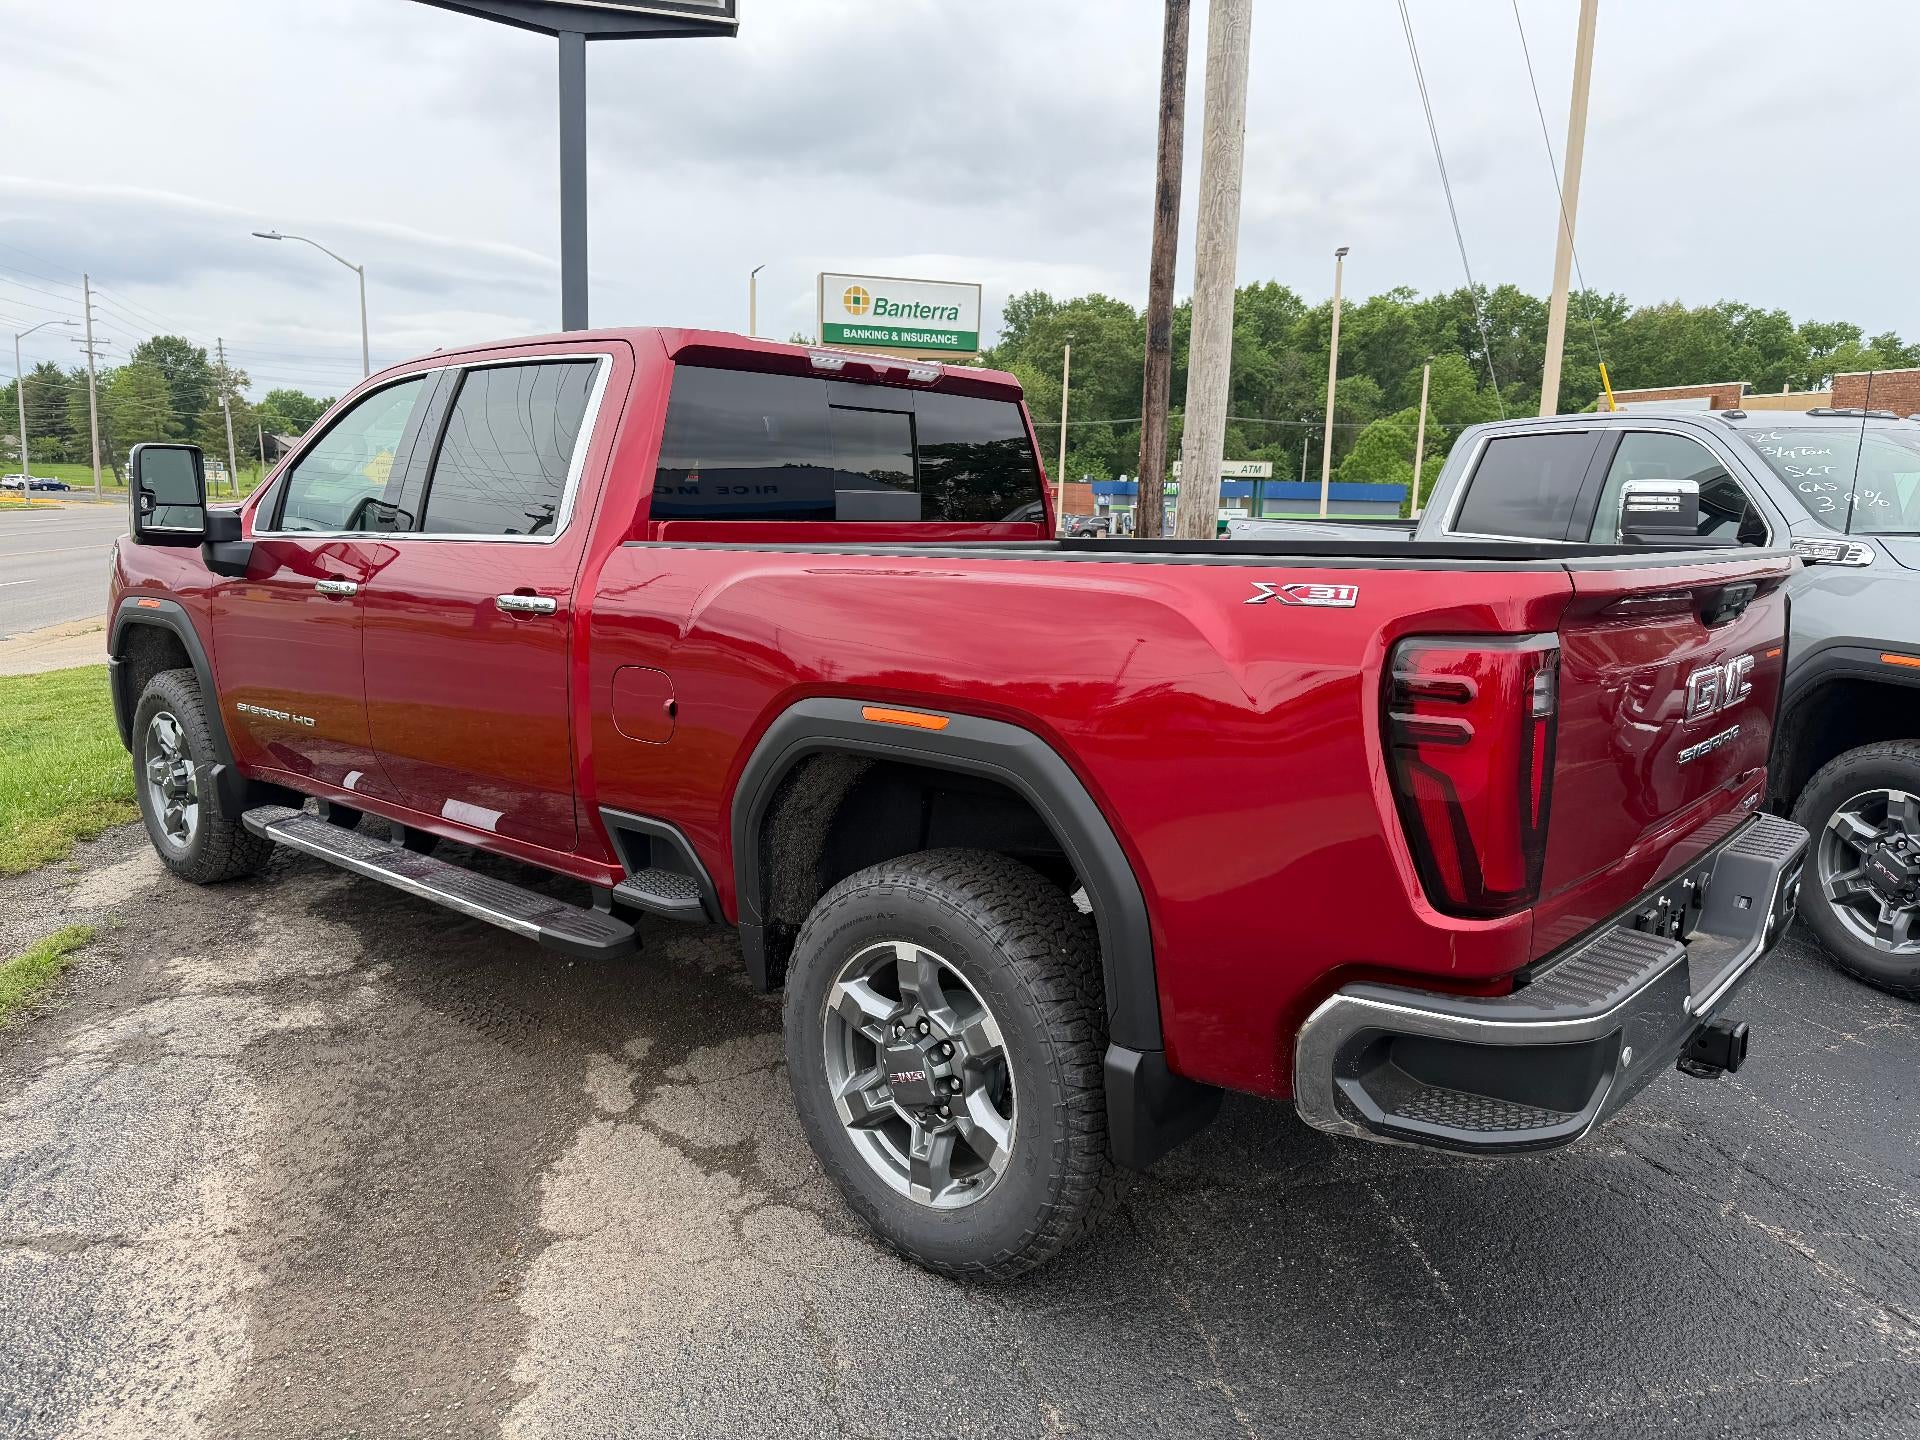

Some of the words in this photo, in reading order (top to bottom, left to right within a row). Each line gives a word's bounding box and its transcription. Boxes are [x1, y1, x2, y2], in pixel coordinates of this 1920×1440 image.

[873, 298, 959, 321] Banterra
[843, 329, 889, 340] BANKING
[891, 331, 899, 341] &
[901, 332, 958, 344] INSURANCE
[1241, 465, 1263, 474] ATM
[1784, 465, 1838, 478] SLT
[1798, 481, 1838, 493] GAS
[1243, 582, 1359, 608] X31
[1684, 654, 1755, 724] GMC
[236, 702, 291, 722] SIERRA
[292, 714, 317, 728] HD
[1677, 724, 1741, 764] SIERRA
